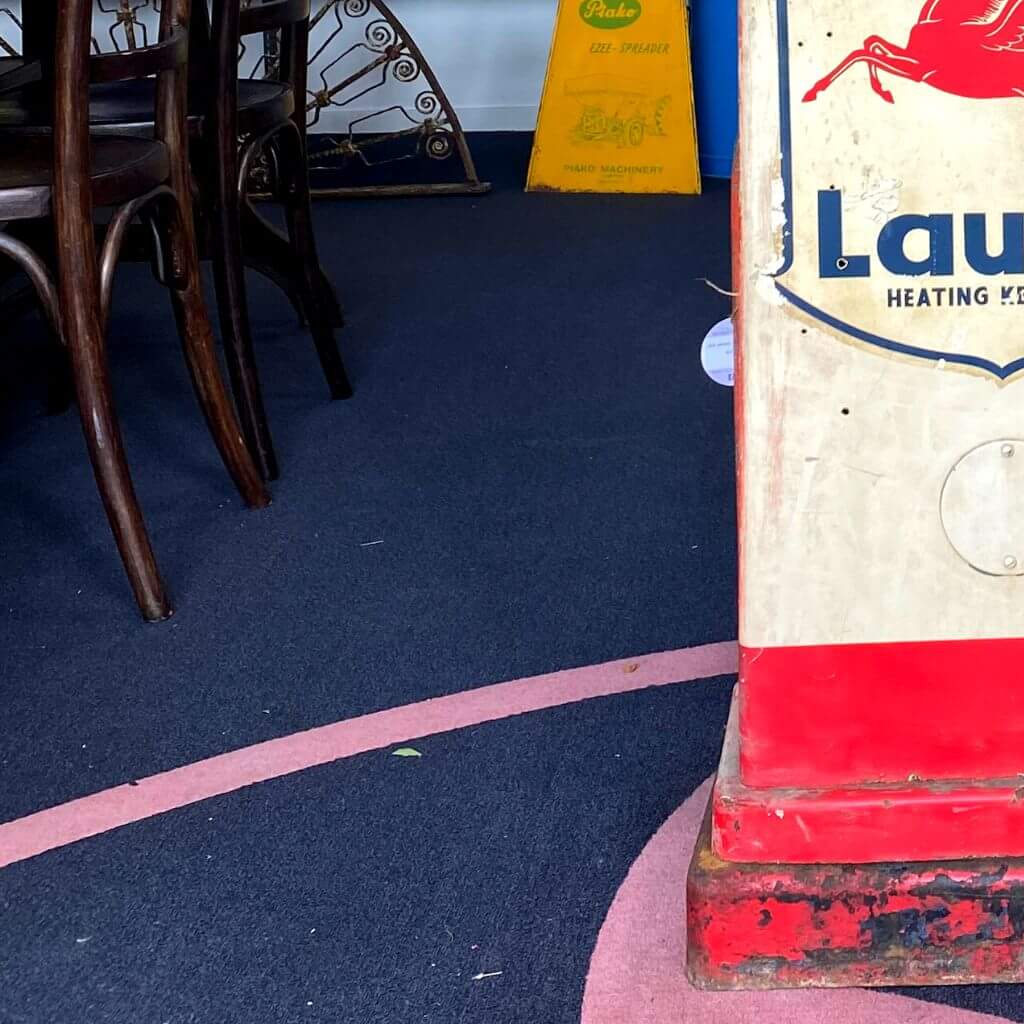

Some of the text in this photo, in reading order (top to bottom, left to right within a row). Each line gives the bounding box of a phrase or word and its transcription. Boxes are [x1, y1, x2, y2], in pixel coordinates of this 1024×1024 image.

[619, 42, 671, 54] SPREADER
[600, 165, 665, 174] MACHINERY
[887, 286, 989, 308] HEATING
